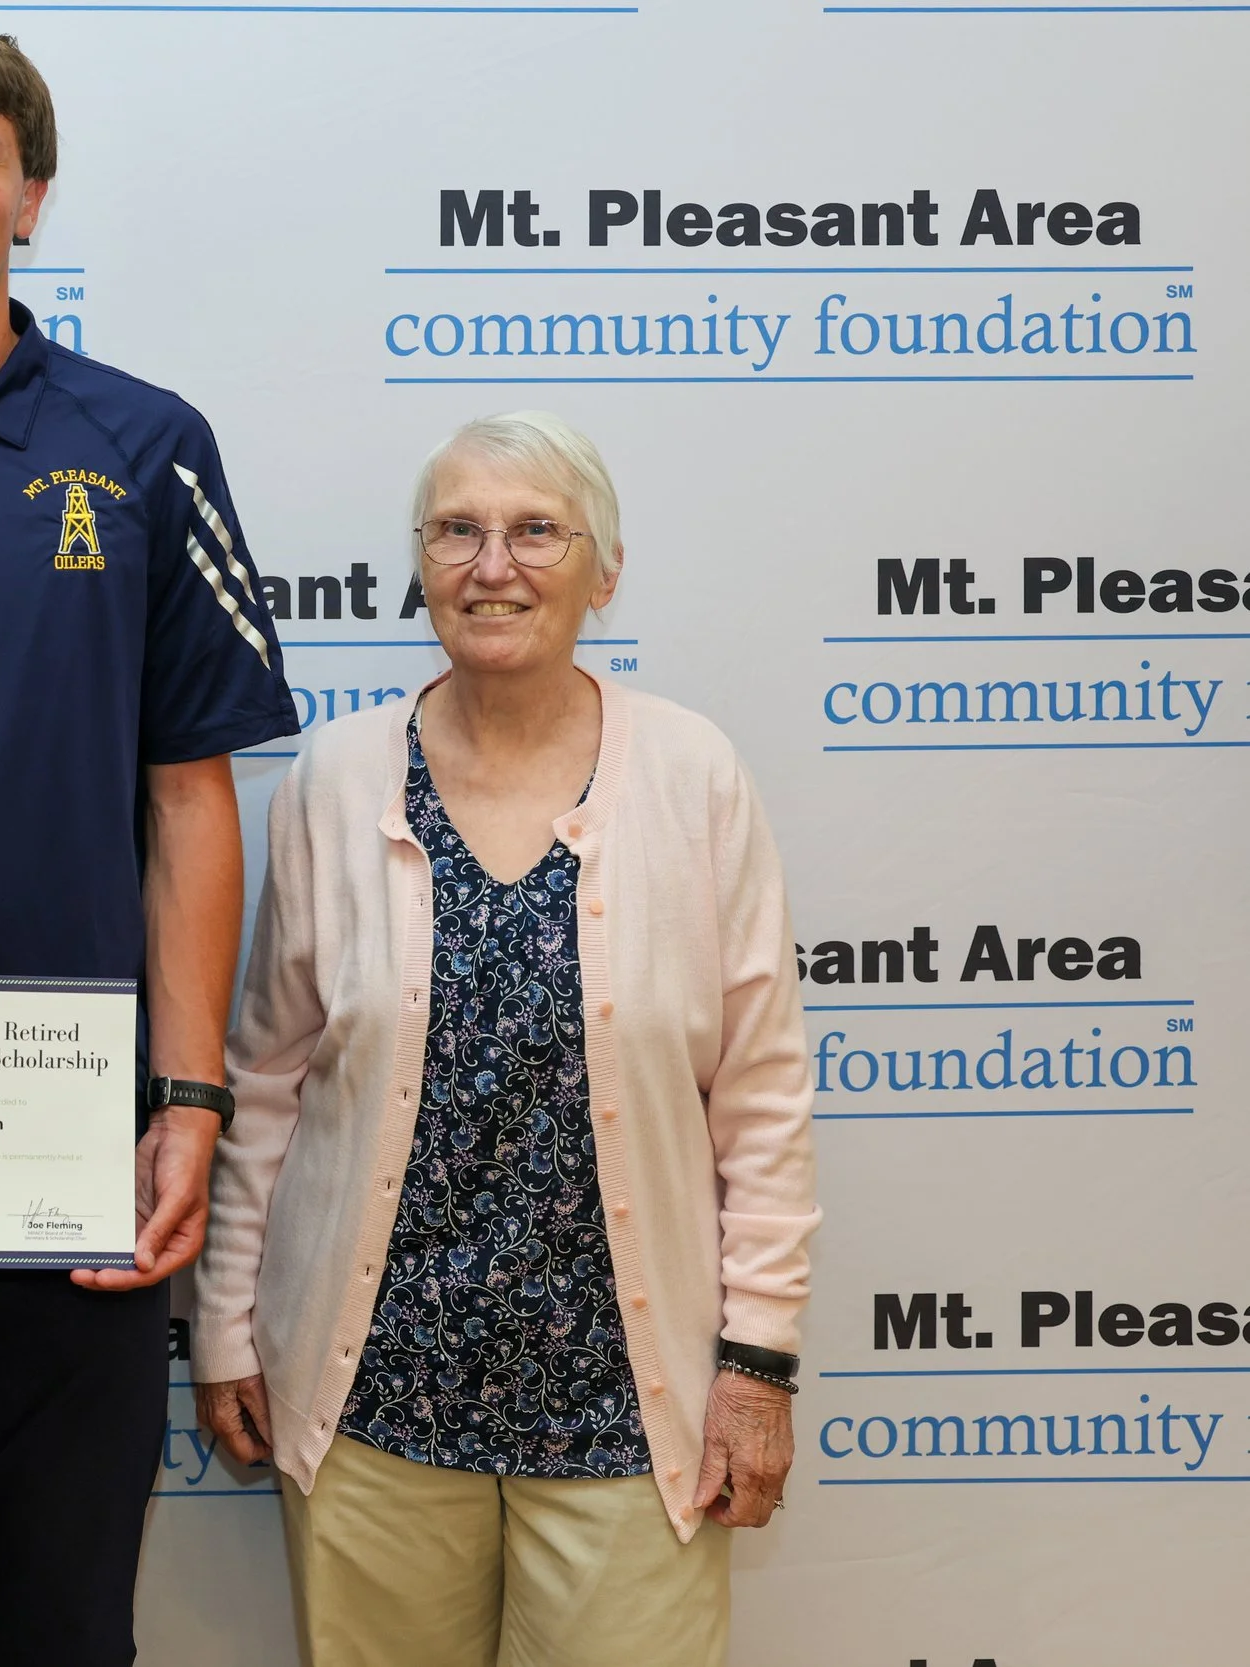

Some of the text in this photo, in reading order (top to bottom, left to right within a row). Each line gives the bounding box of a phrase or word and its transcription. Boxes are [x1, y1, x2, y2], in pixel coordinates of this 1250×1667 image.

[440, 188, 1141, 247] Mt. Pleasant Area
[56, 287, 84, 300] SM
[1166, 284, 1193, 298] SM
[385, 293, 1197, 371] community foundation
[22, 469, 127, 500] MT. PLEASANT
[54, 555, 106, 570] OILERS
[877, 556, 1250, 615] Mt. Pleas
[610, 657, 638, 672] SM
[823, 660, 1223, 737] community
[959, 925, 1142, 982] Area
[3, 1021, 80, 1042] Retired
[1166, 1018, 1194, 1032] SM
[814, 1027, 1198, 1093] foundation
[18, 1098, 28, 1106] to
[27, 1221, 83, 1231] Joe Fleming
[874, 1291, 1250, 1350] Mt. Pleas
[819, 1394, 1223, 1471] community
